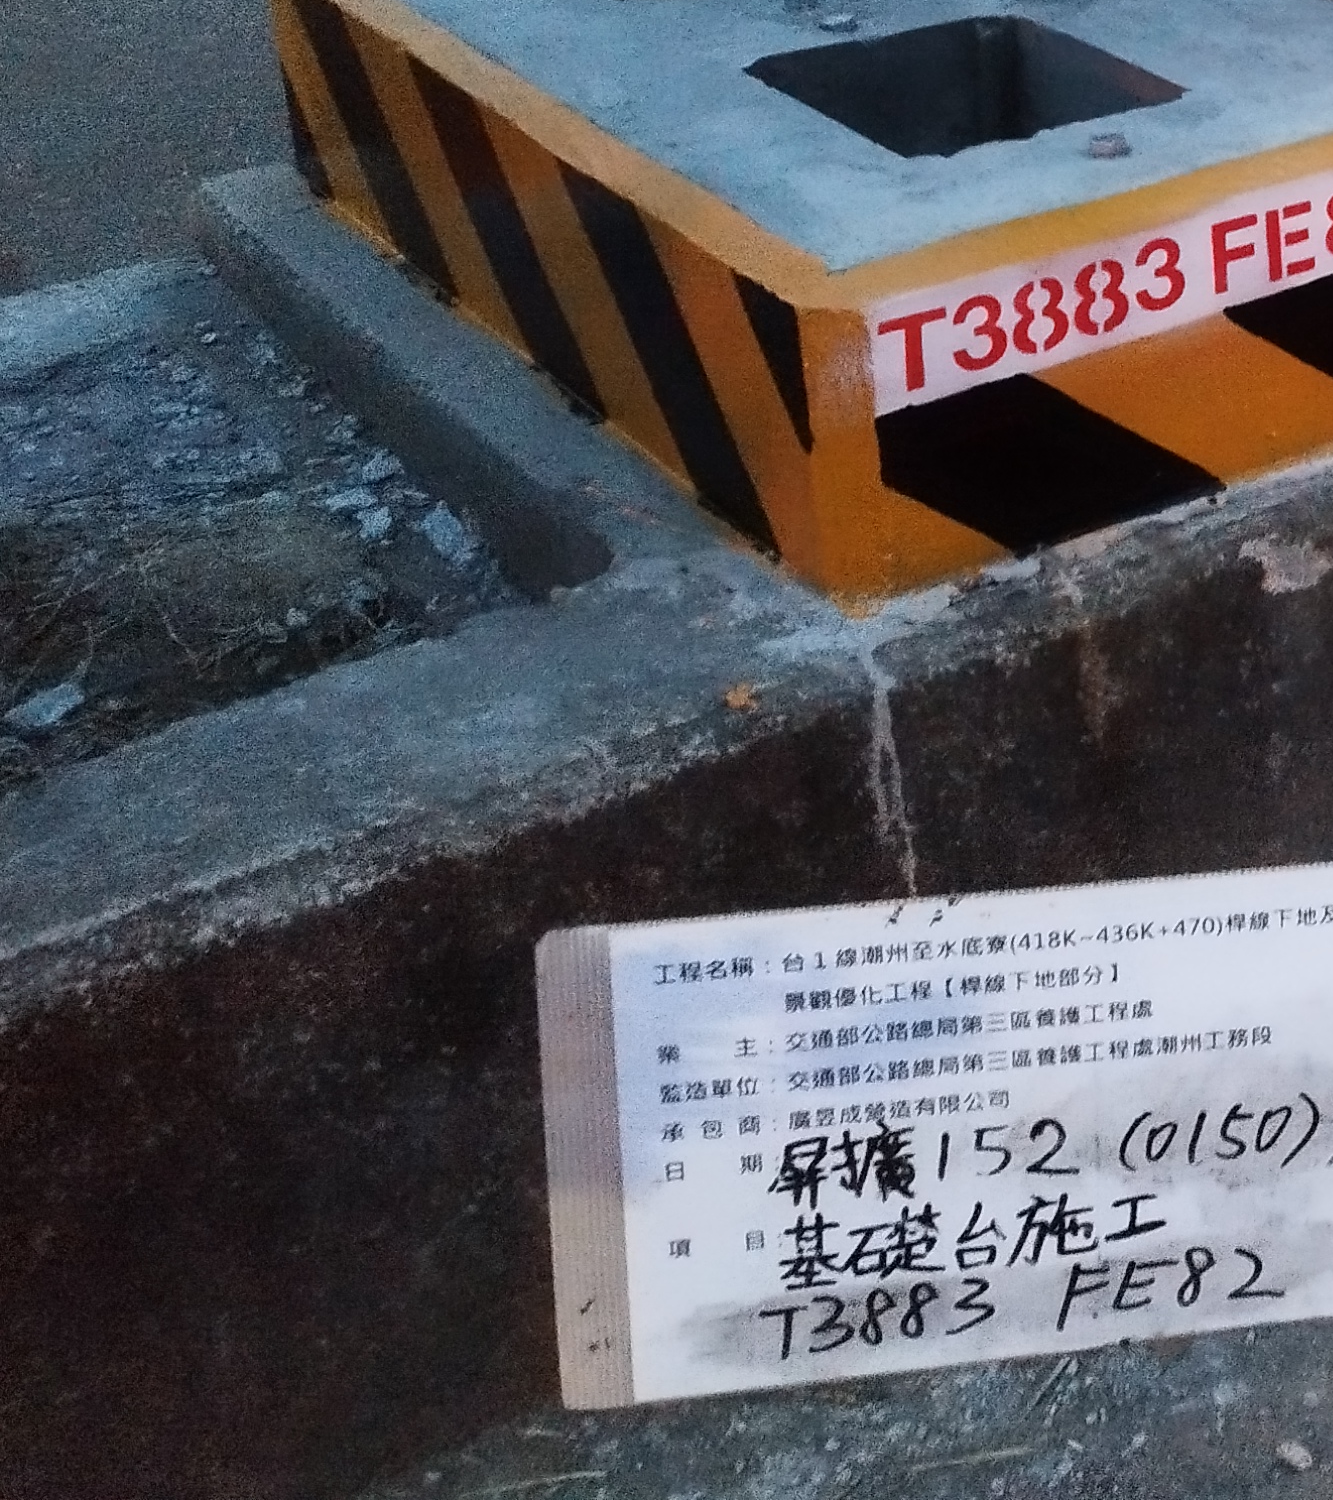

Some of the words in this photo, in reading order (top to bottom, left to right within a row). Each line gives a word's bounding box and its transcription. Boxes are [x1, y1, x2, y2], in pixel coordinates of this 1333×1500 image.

[877, 237, 1186, 393] T3883
[758, 1276, 997, 1361] T3883
[1056, 1248, 1286, 1332] FE82
